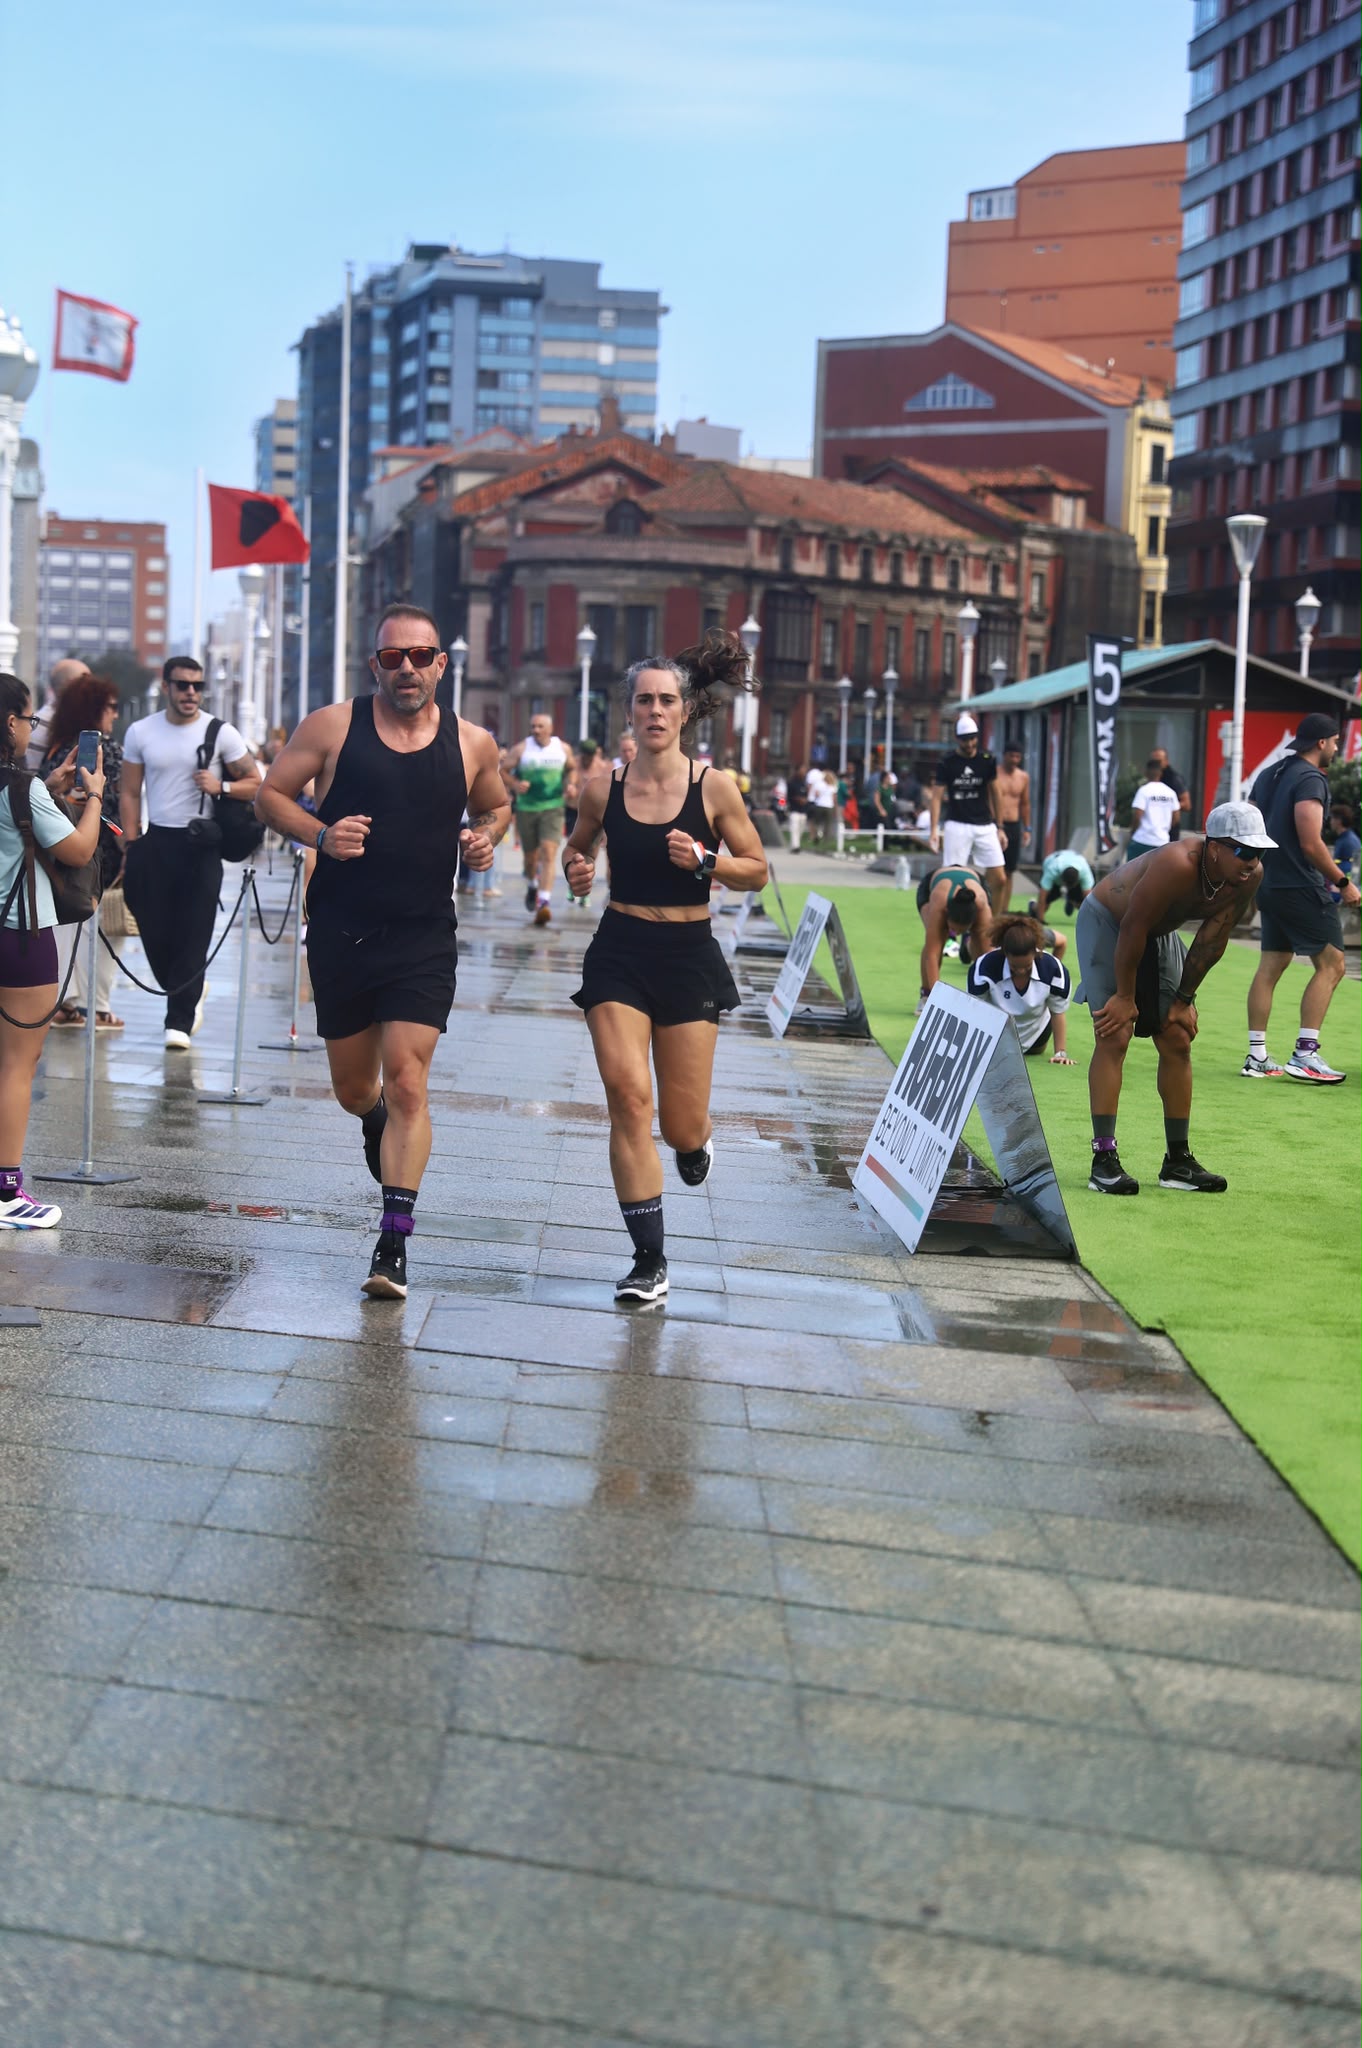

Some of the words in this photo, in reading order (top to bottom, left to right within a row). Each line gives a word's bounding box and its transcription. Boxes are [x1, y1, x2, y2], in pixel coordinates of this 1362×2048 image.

[1093, 642, 1121, 706] 5
[1003, 990, 1011, 1000] 8
[875, 1103, 917, 1165] BEYOND
[909, 1131, 946, 1195] LIMITS
